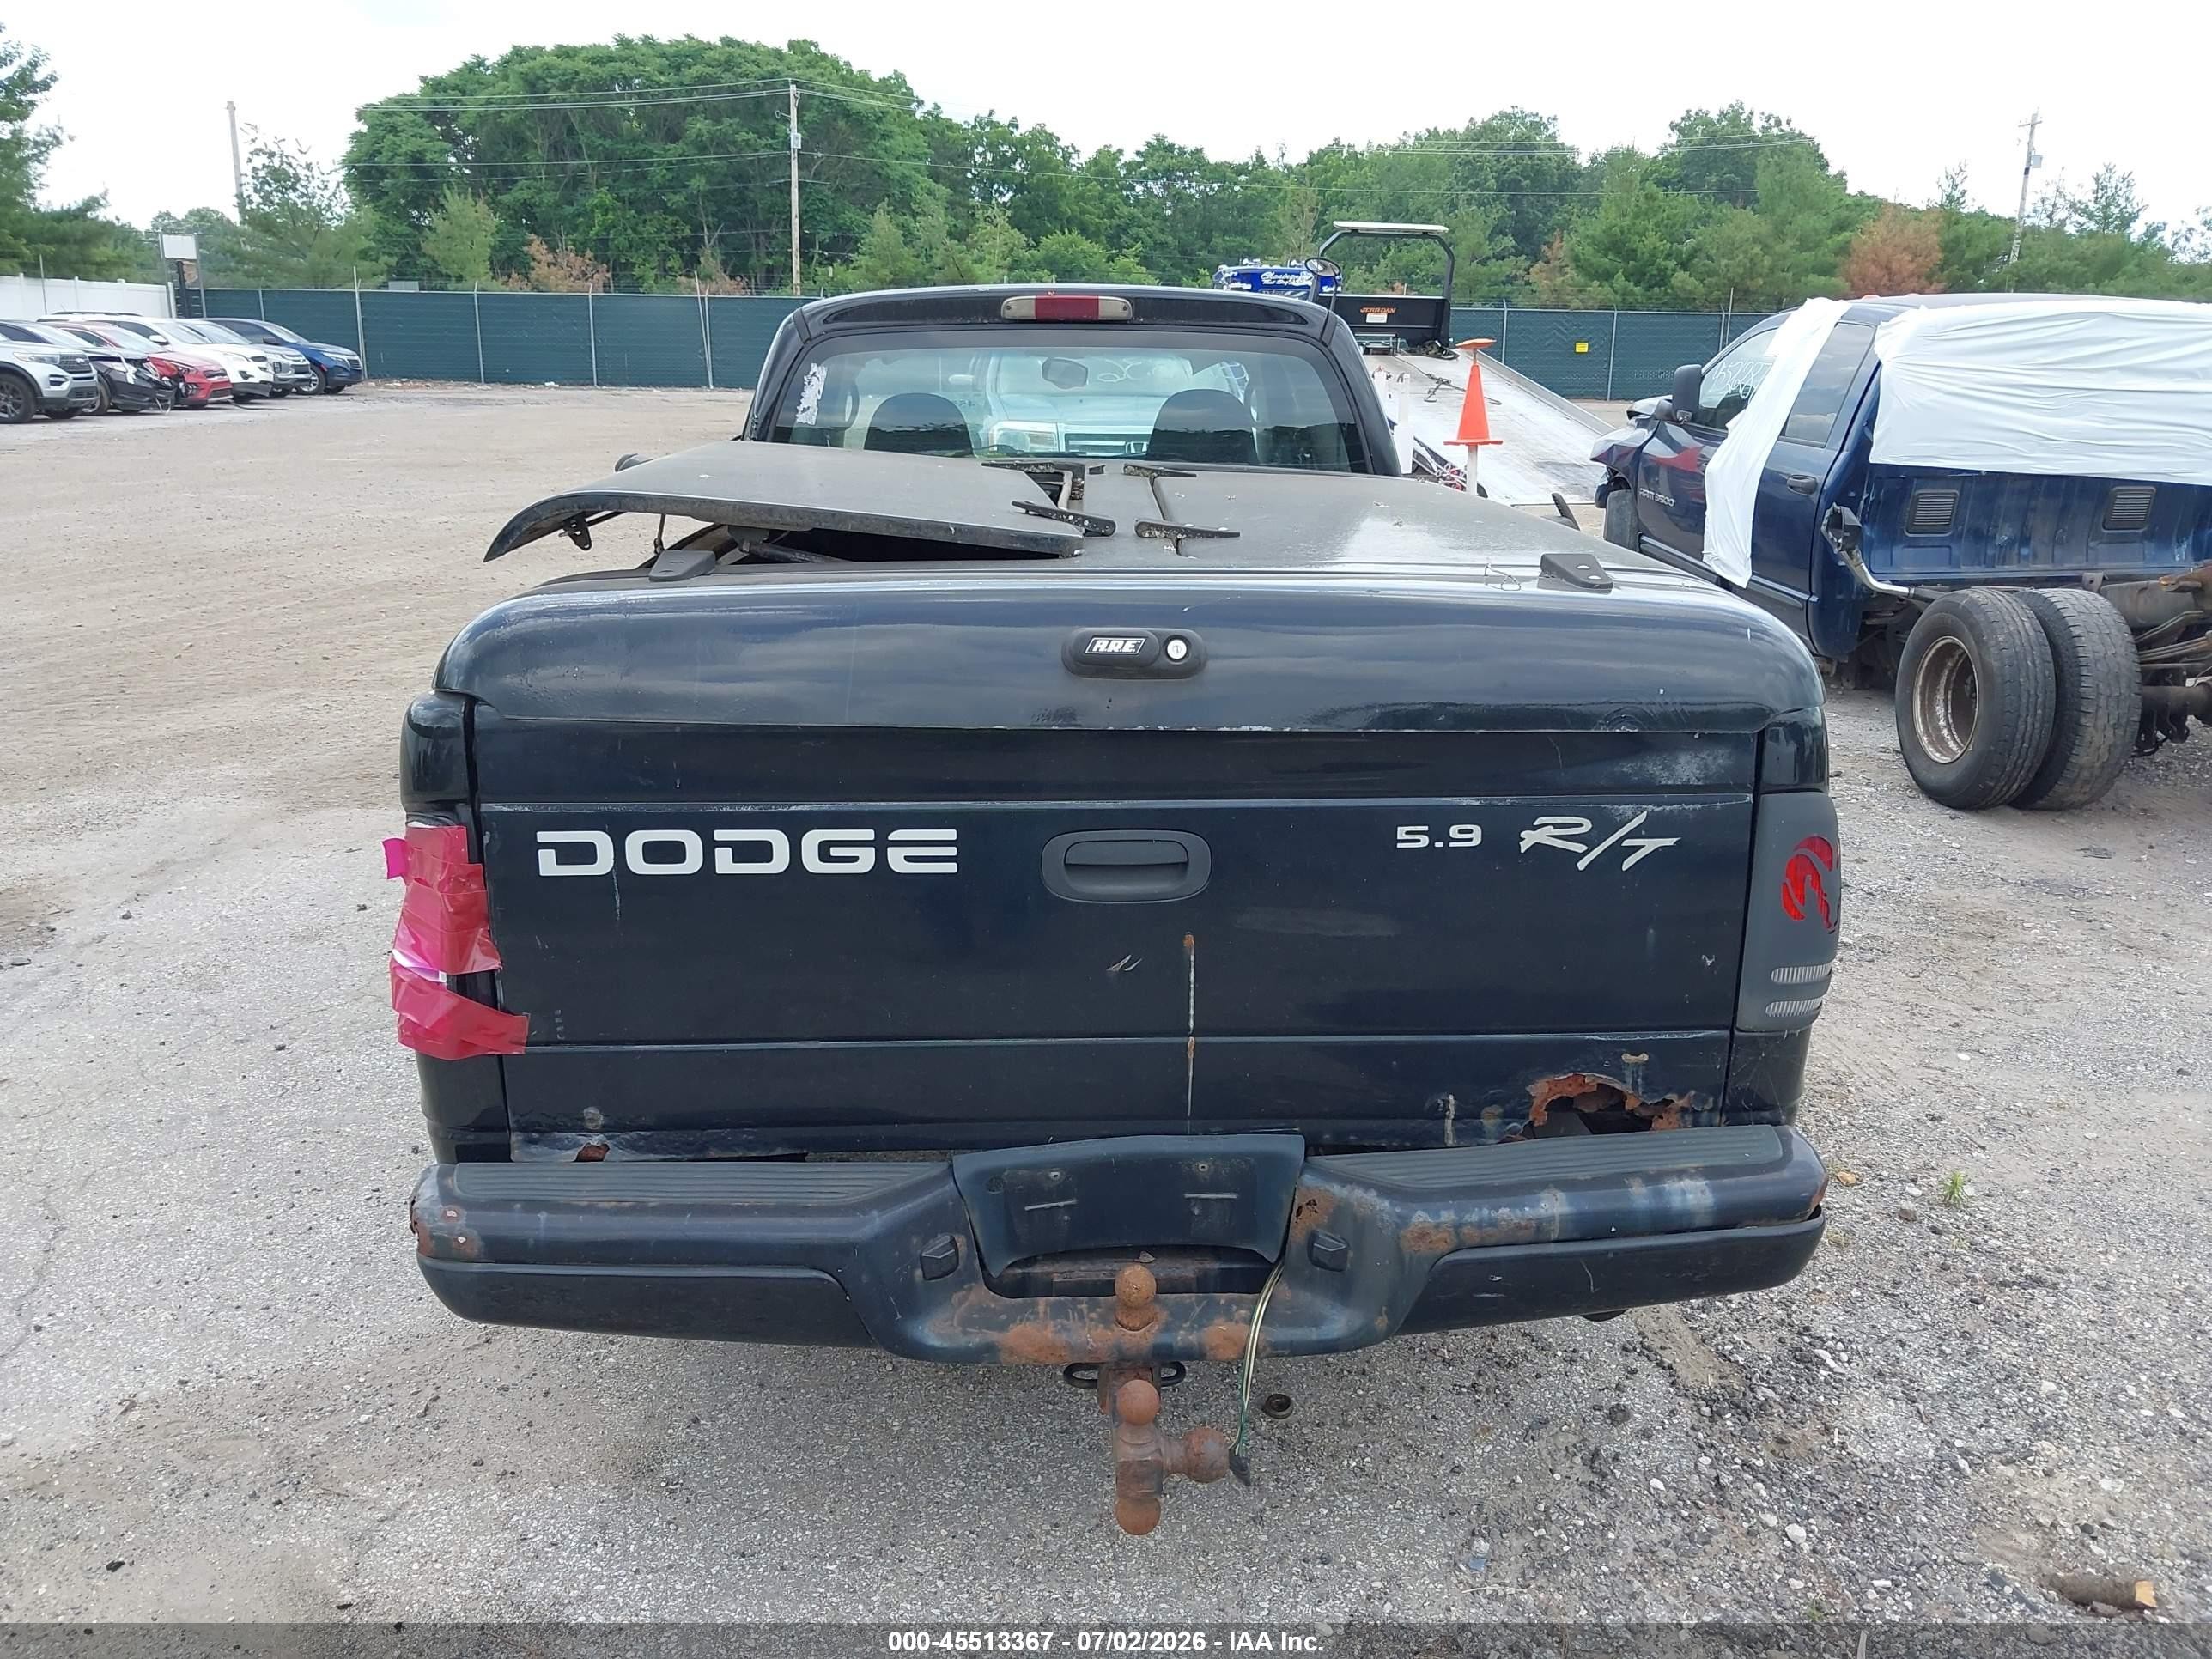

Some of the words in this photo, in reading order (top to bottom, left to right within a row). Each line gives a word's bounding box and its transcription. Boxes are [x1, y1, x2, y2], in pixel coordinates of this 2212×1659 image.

[536, 829, 958, 876] DODGE
[1396, 823, 1482, 848] 5.9
[1519, 811, 1680, 872] R/T
